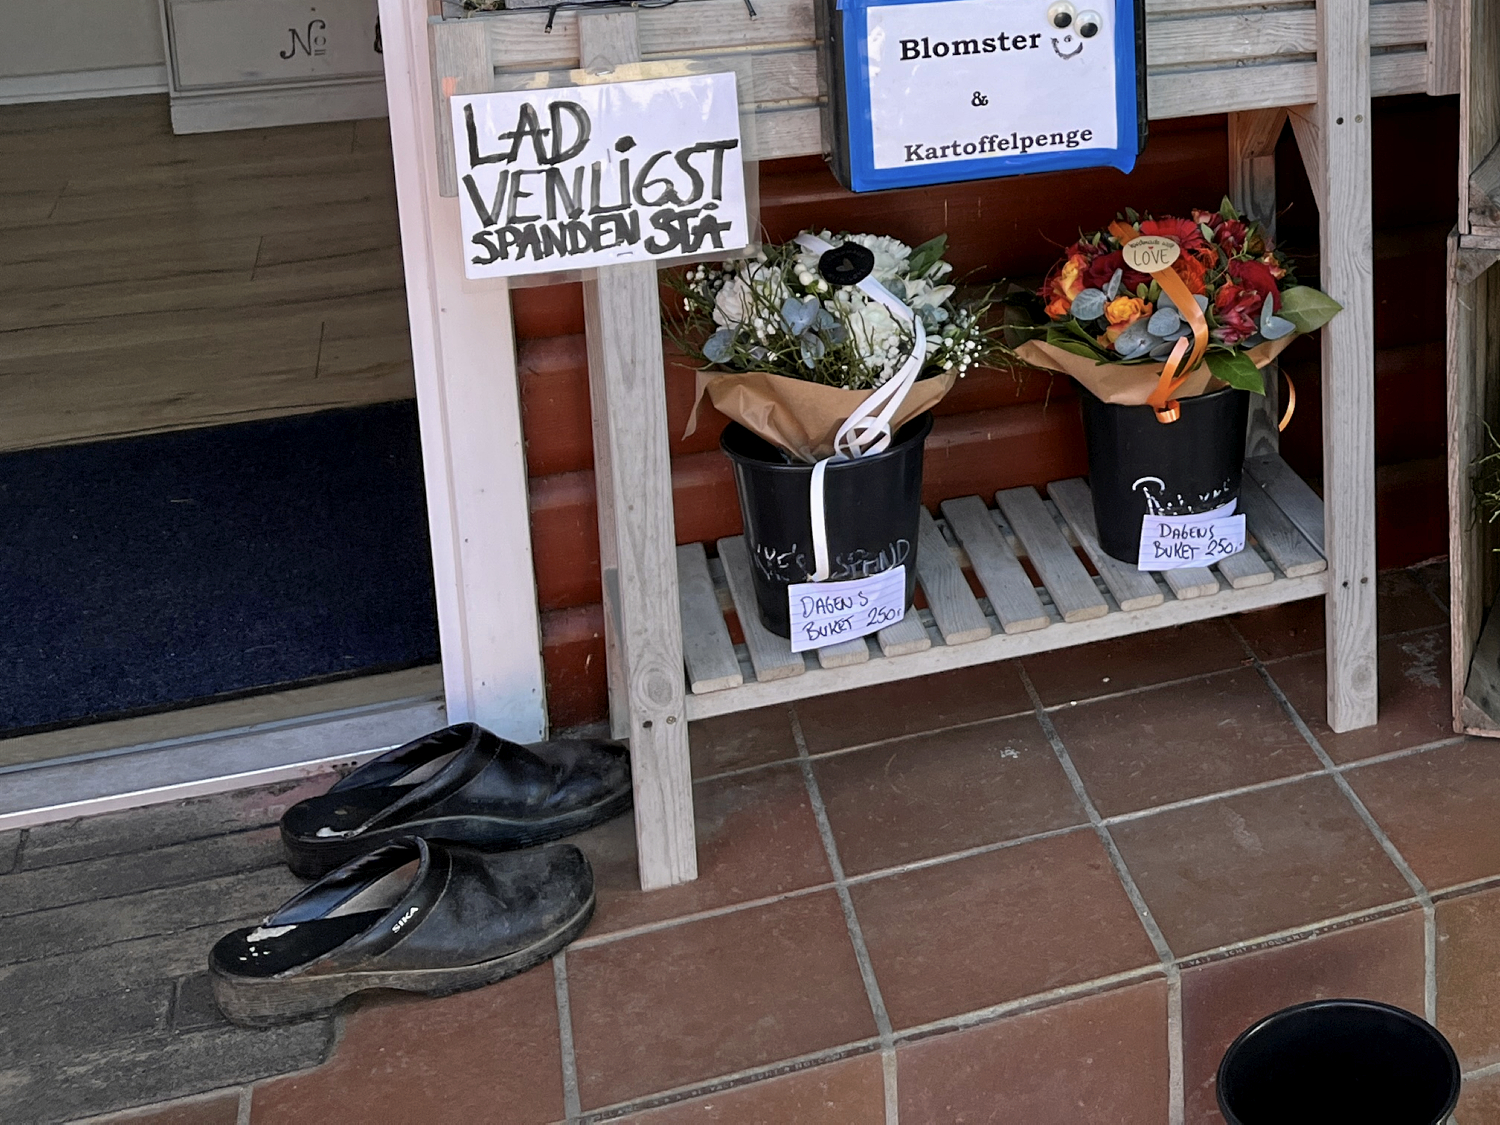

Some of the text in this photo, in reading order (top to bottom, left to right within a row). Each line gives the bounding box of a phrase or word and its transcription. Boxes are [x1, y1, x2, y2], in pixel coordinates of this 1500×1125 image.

[899, 31, 1042, 62] Blomster
[970, 91, 989, 107] &
[463, 100, 592, 170] LAD
[904, 129, 1093, 162] Kartoffelpenge
[471, 202, 732, 265] SPANDEN STÅ
[1134, 249, 1169, 266] LOVE
[1158, 523, 1214, 541] DAGENS
[1153, 540, 1200, 560] BUKET
[802, 614, 854, 641] BUKET
[392, 907, 419, 933] SIKA
